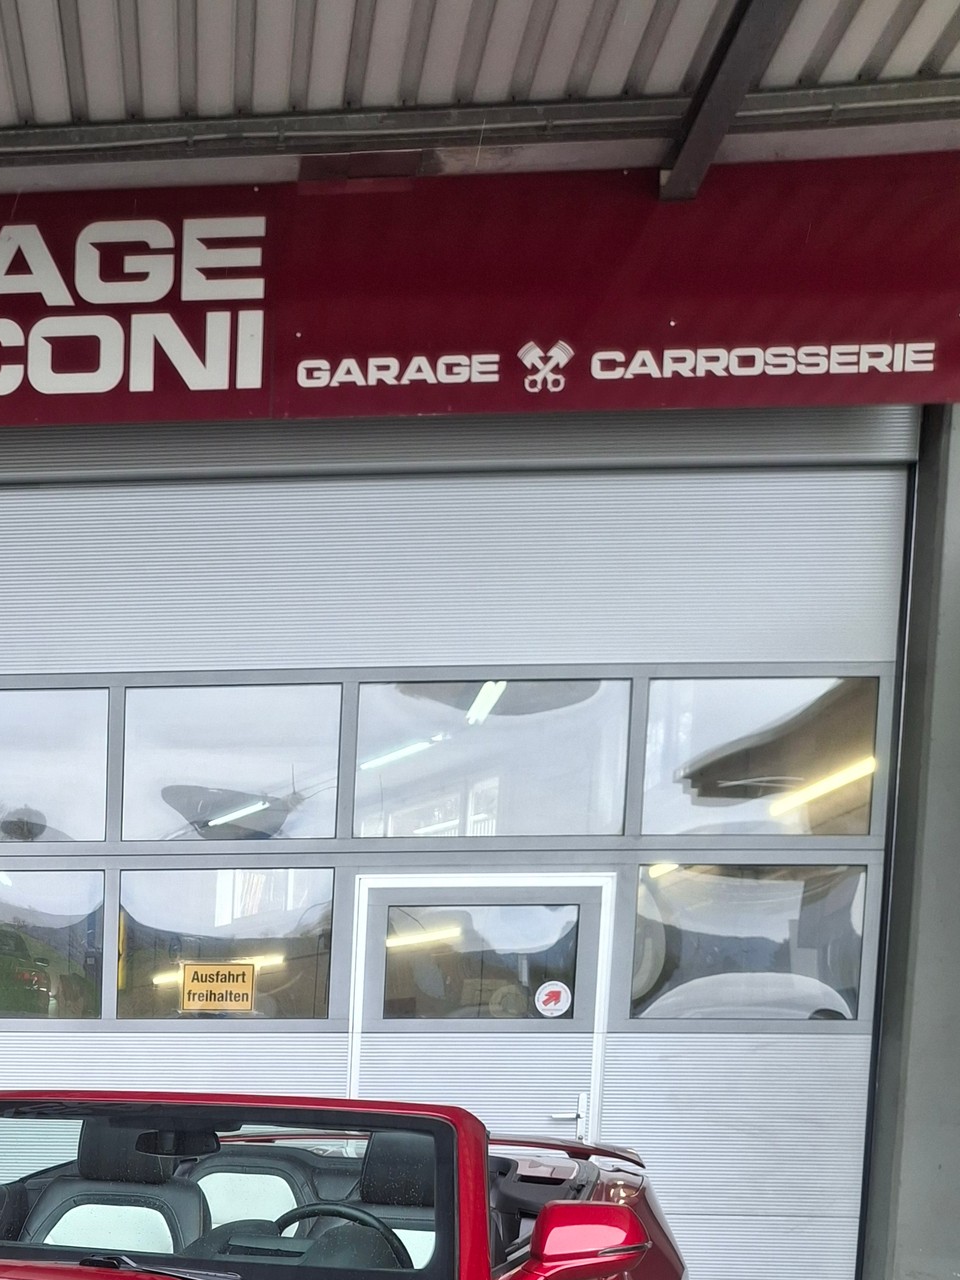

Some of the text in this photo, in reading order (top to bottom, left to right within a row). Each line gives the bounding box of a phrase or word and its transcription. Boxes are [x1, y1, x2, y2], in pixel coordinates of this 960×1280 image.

[297, 342, 935, 388] GARAGE CARROSSERIE
[191, 971, 246, 983] Ausfahrt
[187, 990, 249, 1002] freihalten
